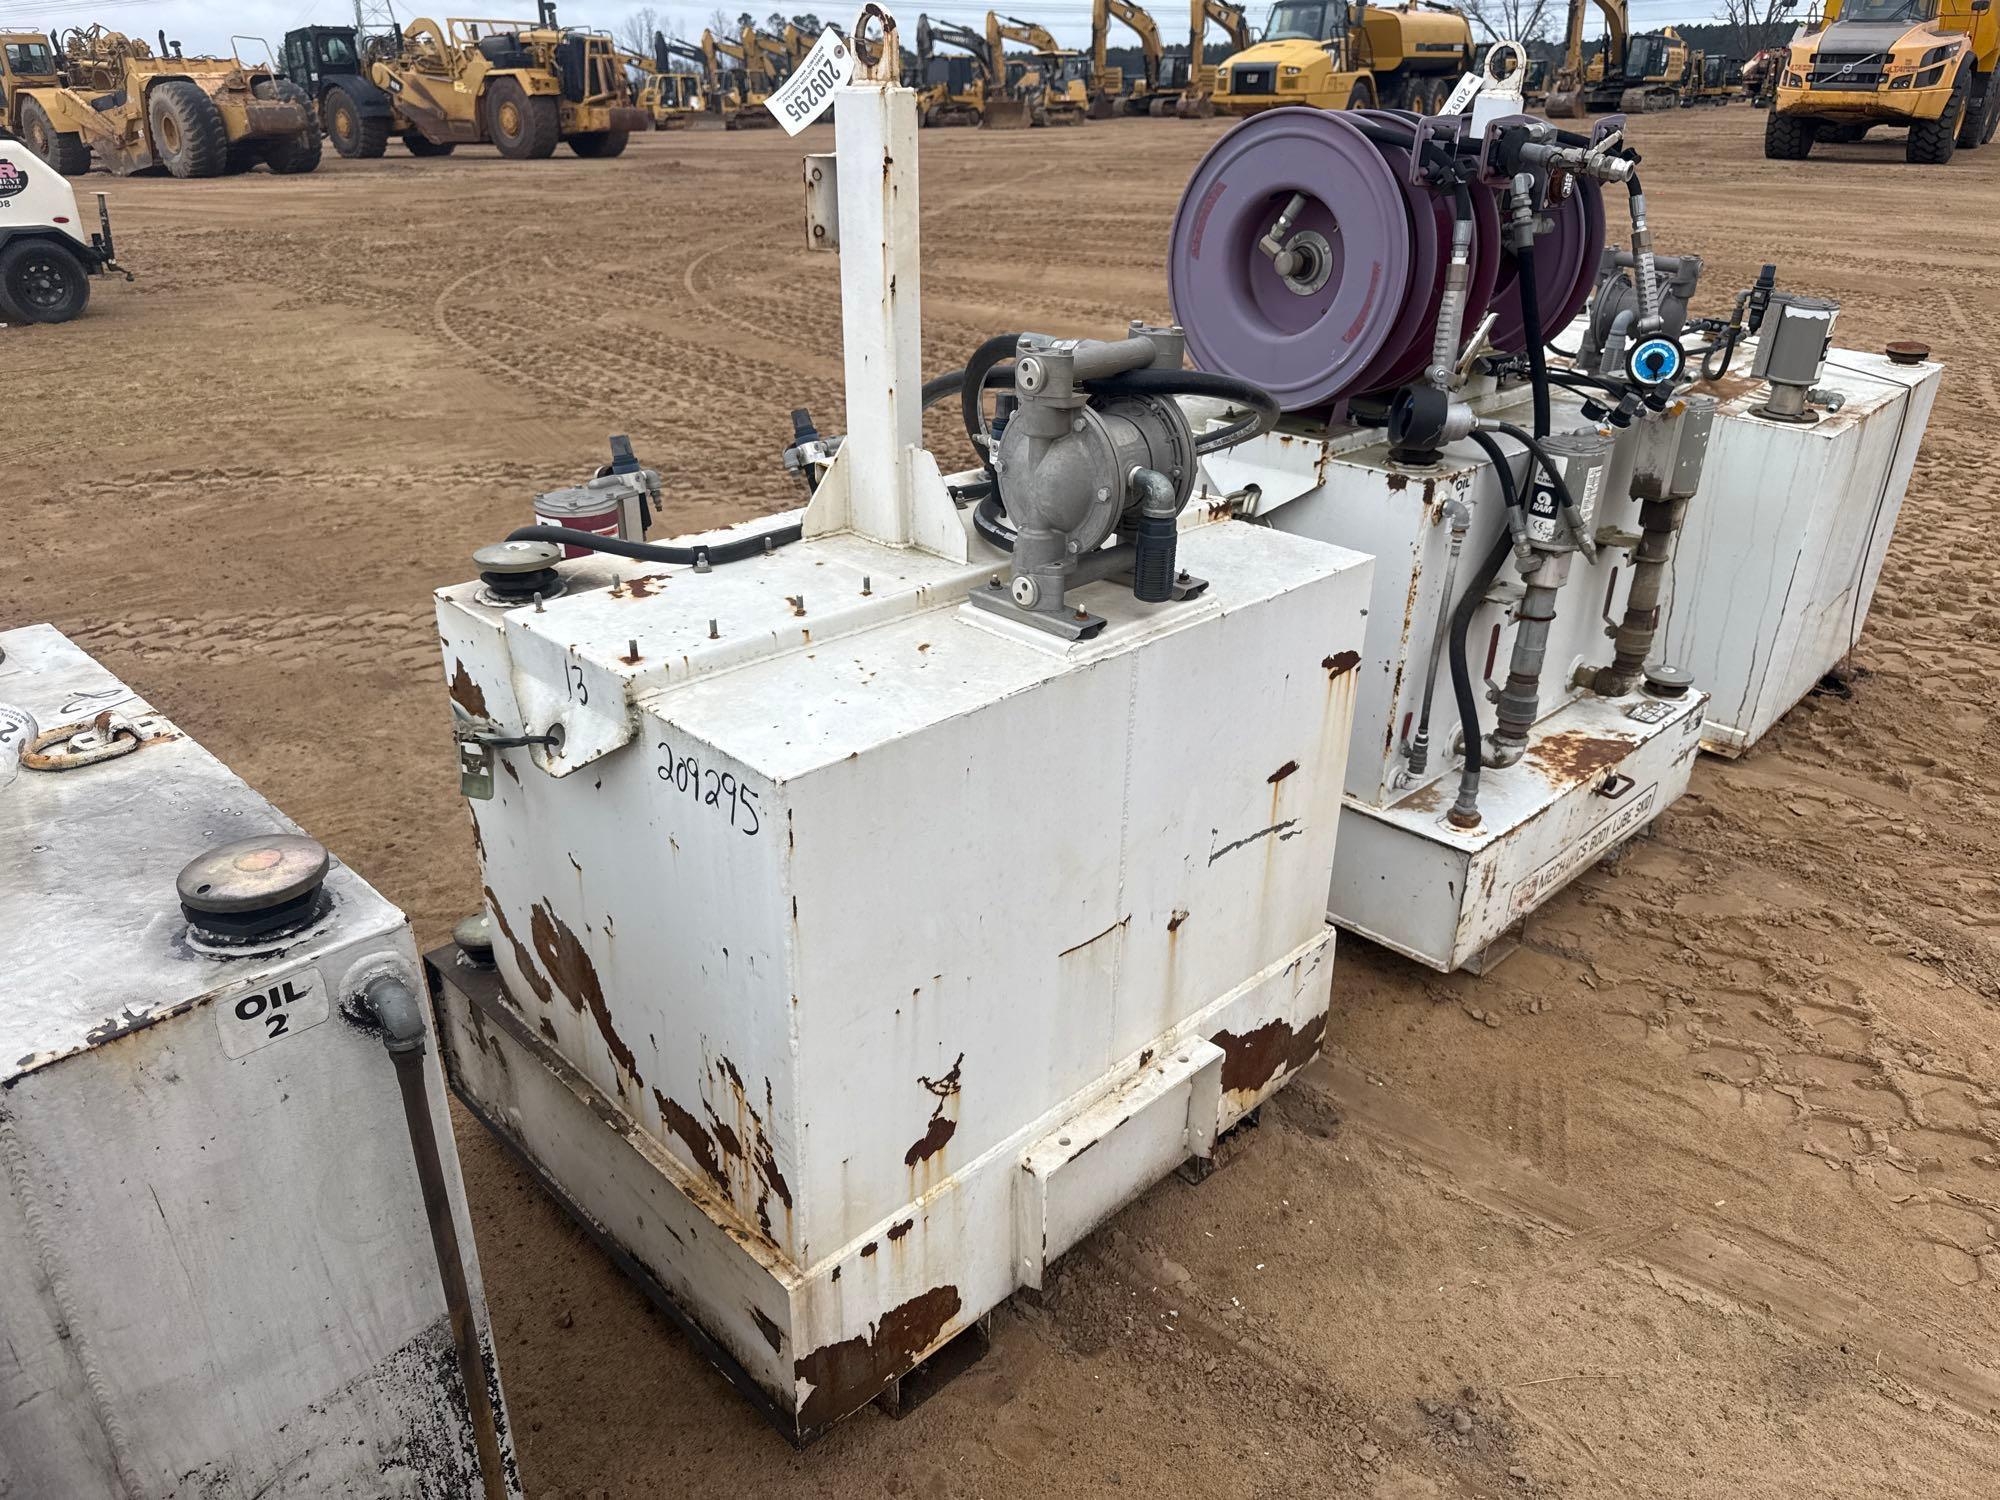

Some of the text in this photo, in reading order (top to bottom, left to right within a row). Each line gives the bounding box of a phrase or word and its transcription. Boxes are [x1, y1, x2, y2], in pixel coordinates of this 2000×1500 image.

[784, 58, 841, 122] 209295
[1456, 478, 1470, 491] OIL
[1459, 492, 1464, 502] 1
[1532, 502, 1554, 514] RAM
[564, 657, 588, 706] 13
[657, 742, 760, 836] 209295
[1589, 826, 1612, 852] BODY
[1611, 807, 1635, 835] LUBE
[1634, 793, 1652, 818] SKID
[235, 981, 311, 1021] OIL
[265, 1013, 289, 1039] 2
